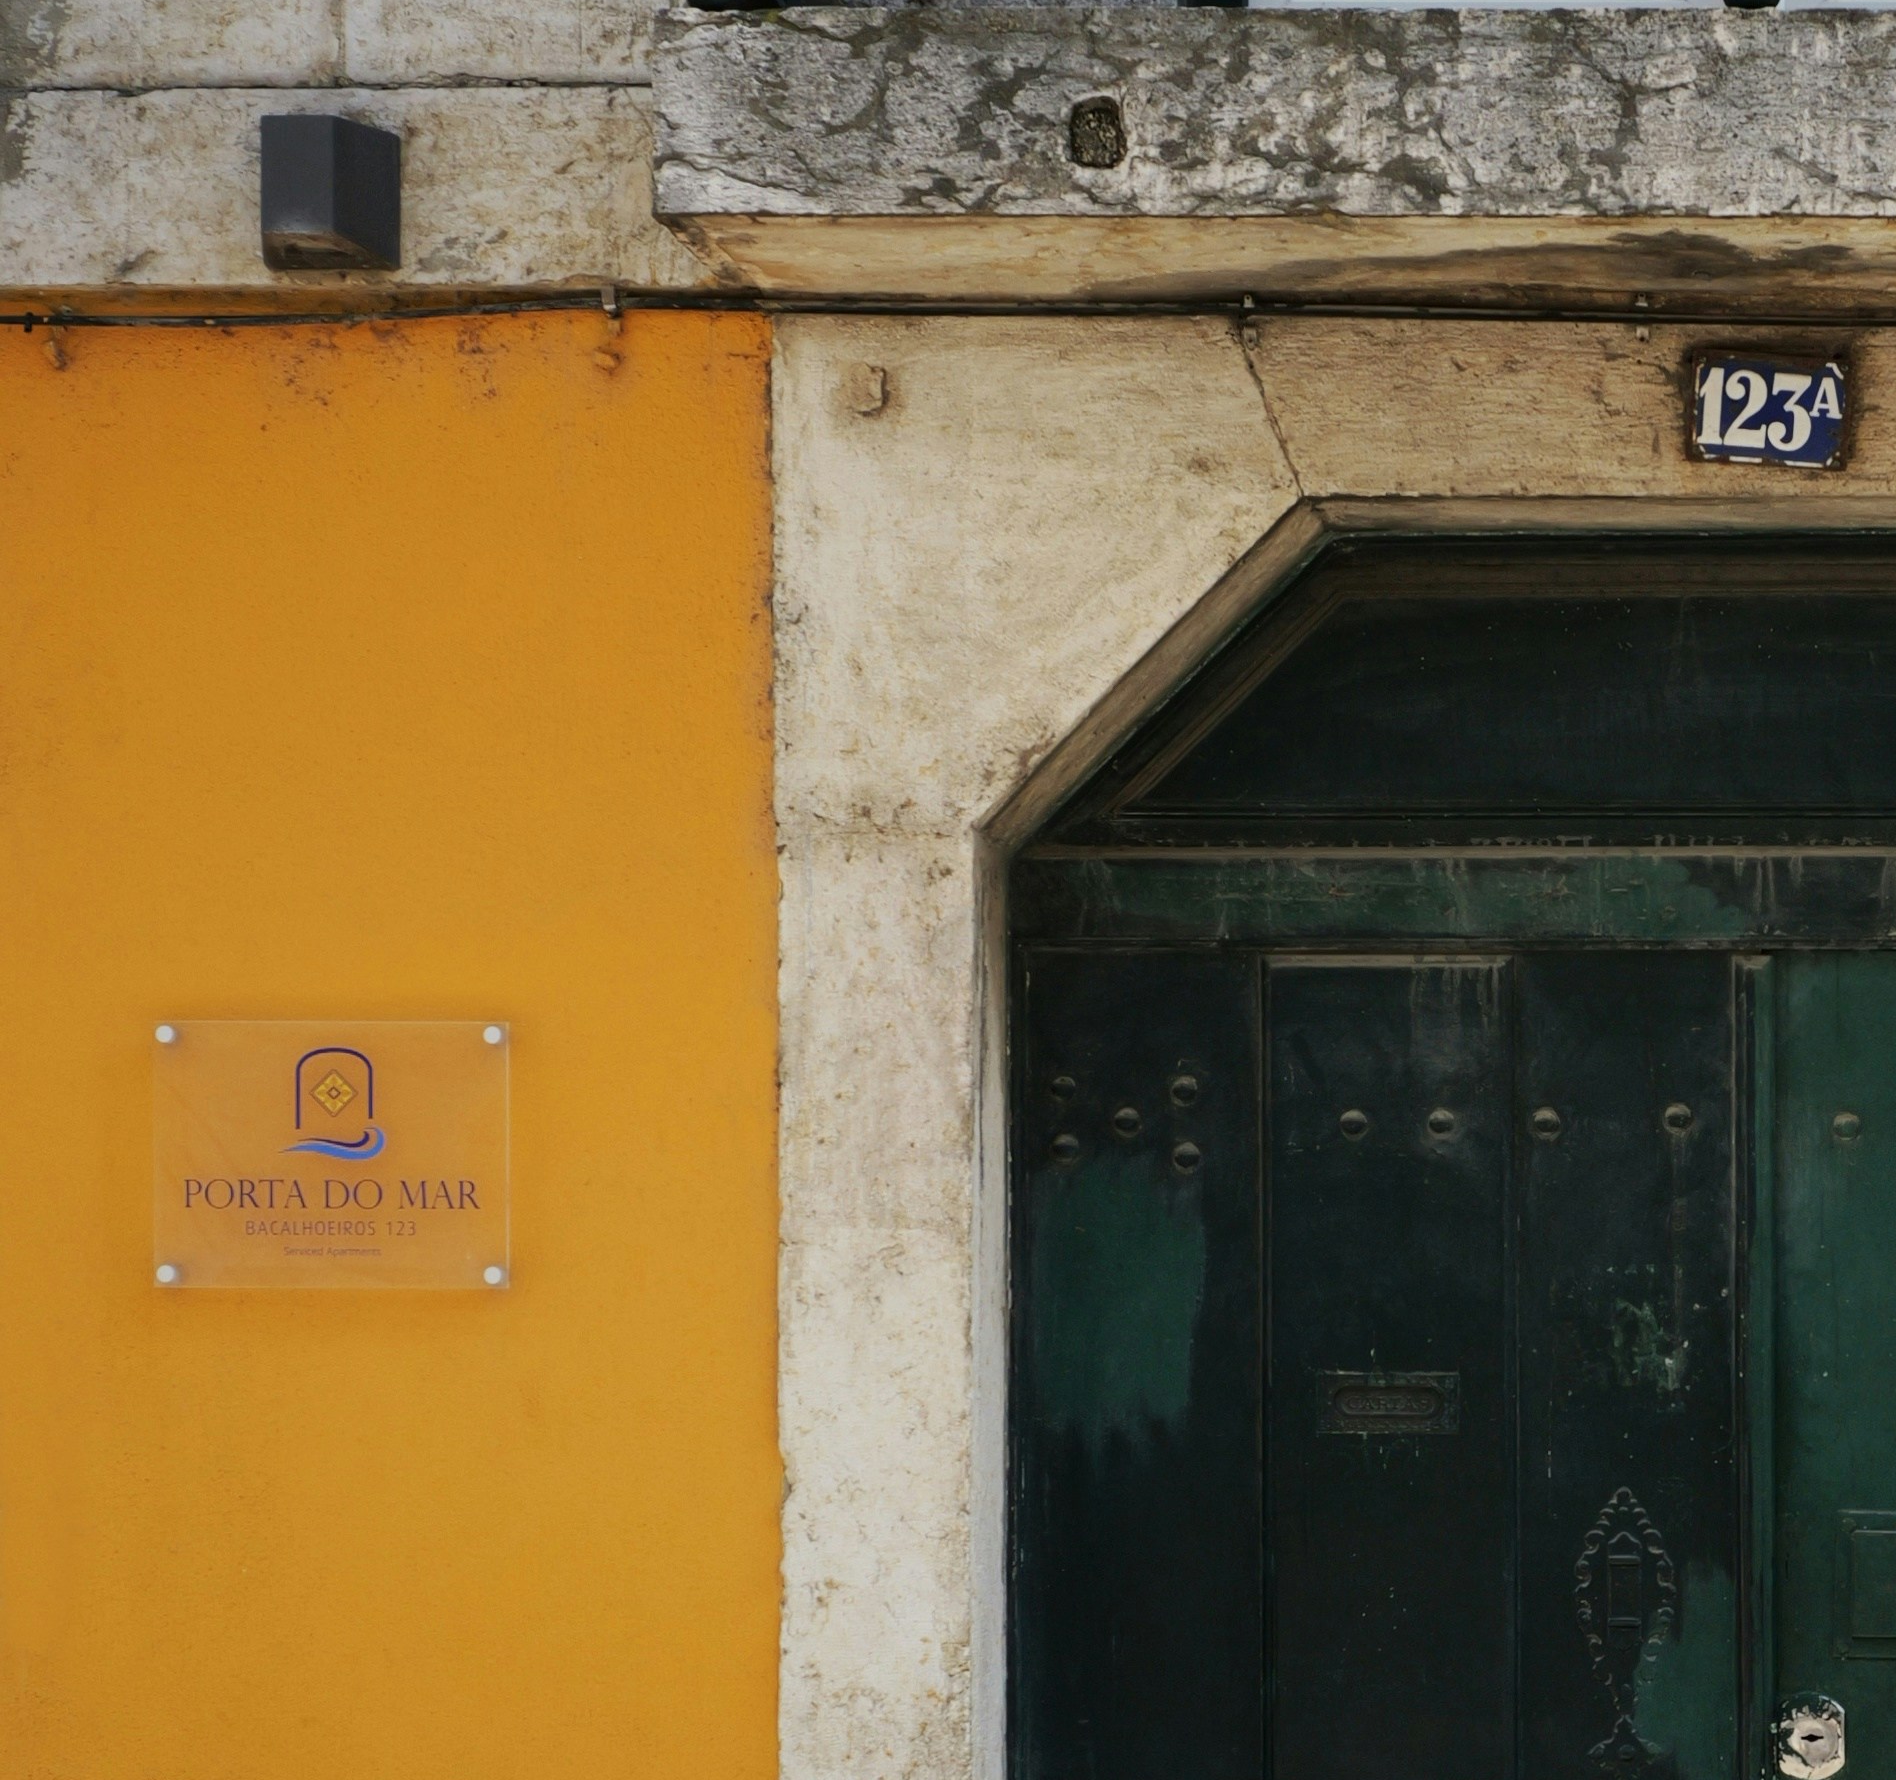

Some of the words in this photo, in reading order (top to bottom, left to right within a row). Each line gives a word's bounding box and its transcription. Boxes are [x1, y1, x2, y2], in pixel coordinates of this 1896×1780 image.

[184, 1178, 307, 1210] PORTA
[324, 1178, 383, 1210] DO
[398, 1179, 481, 1210] MAR
[245, 1220, 376, 1236] BACALHOEIROS
[386, 1220, 417, 1236] 123
[283, 1246, 324, 1256] Serviced
